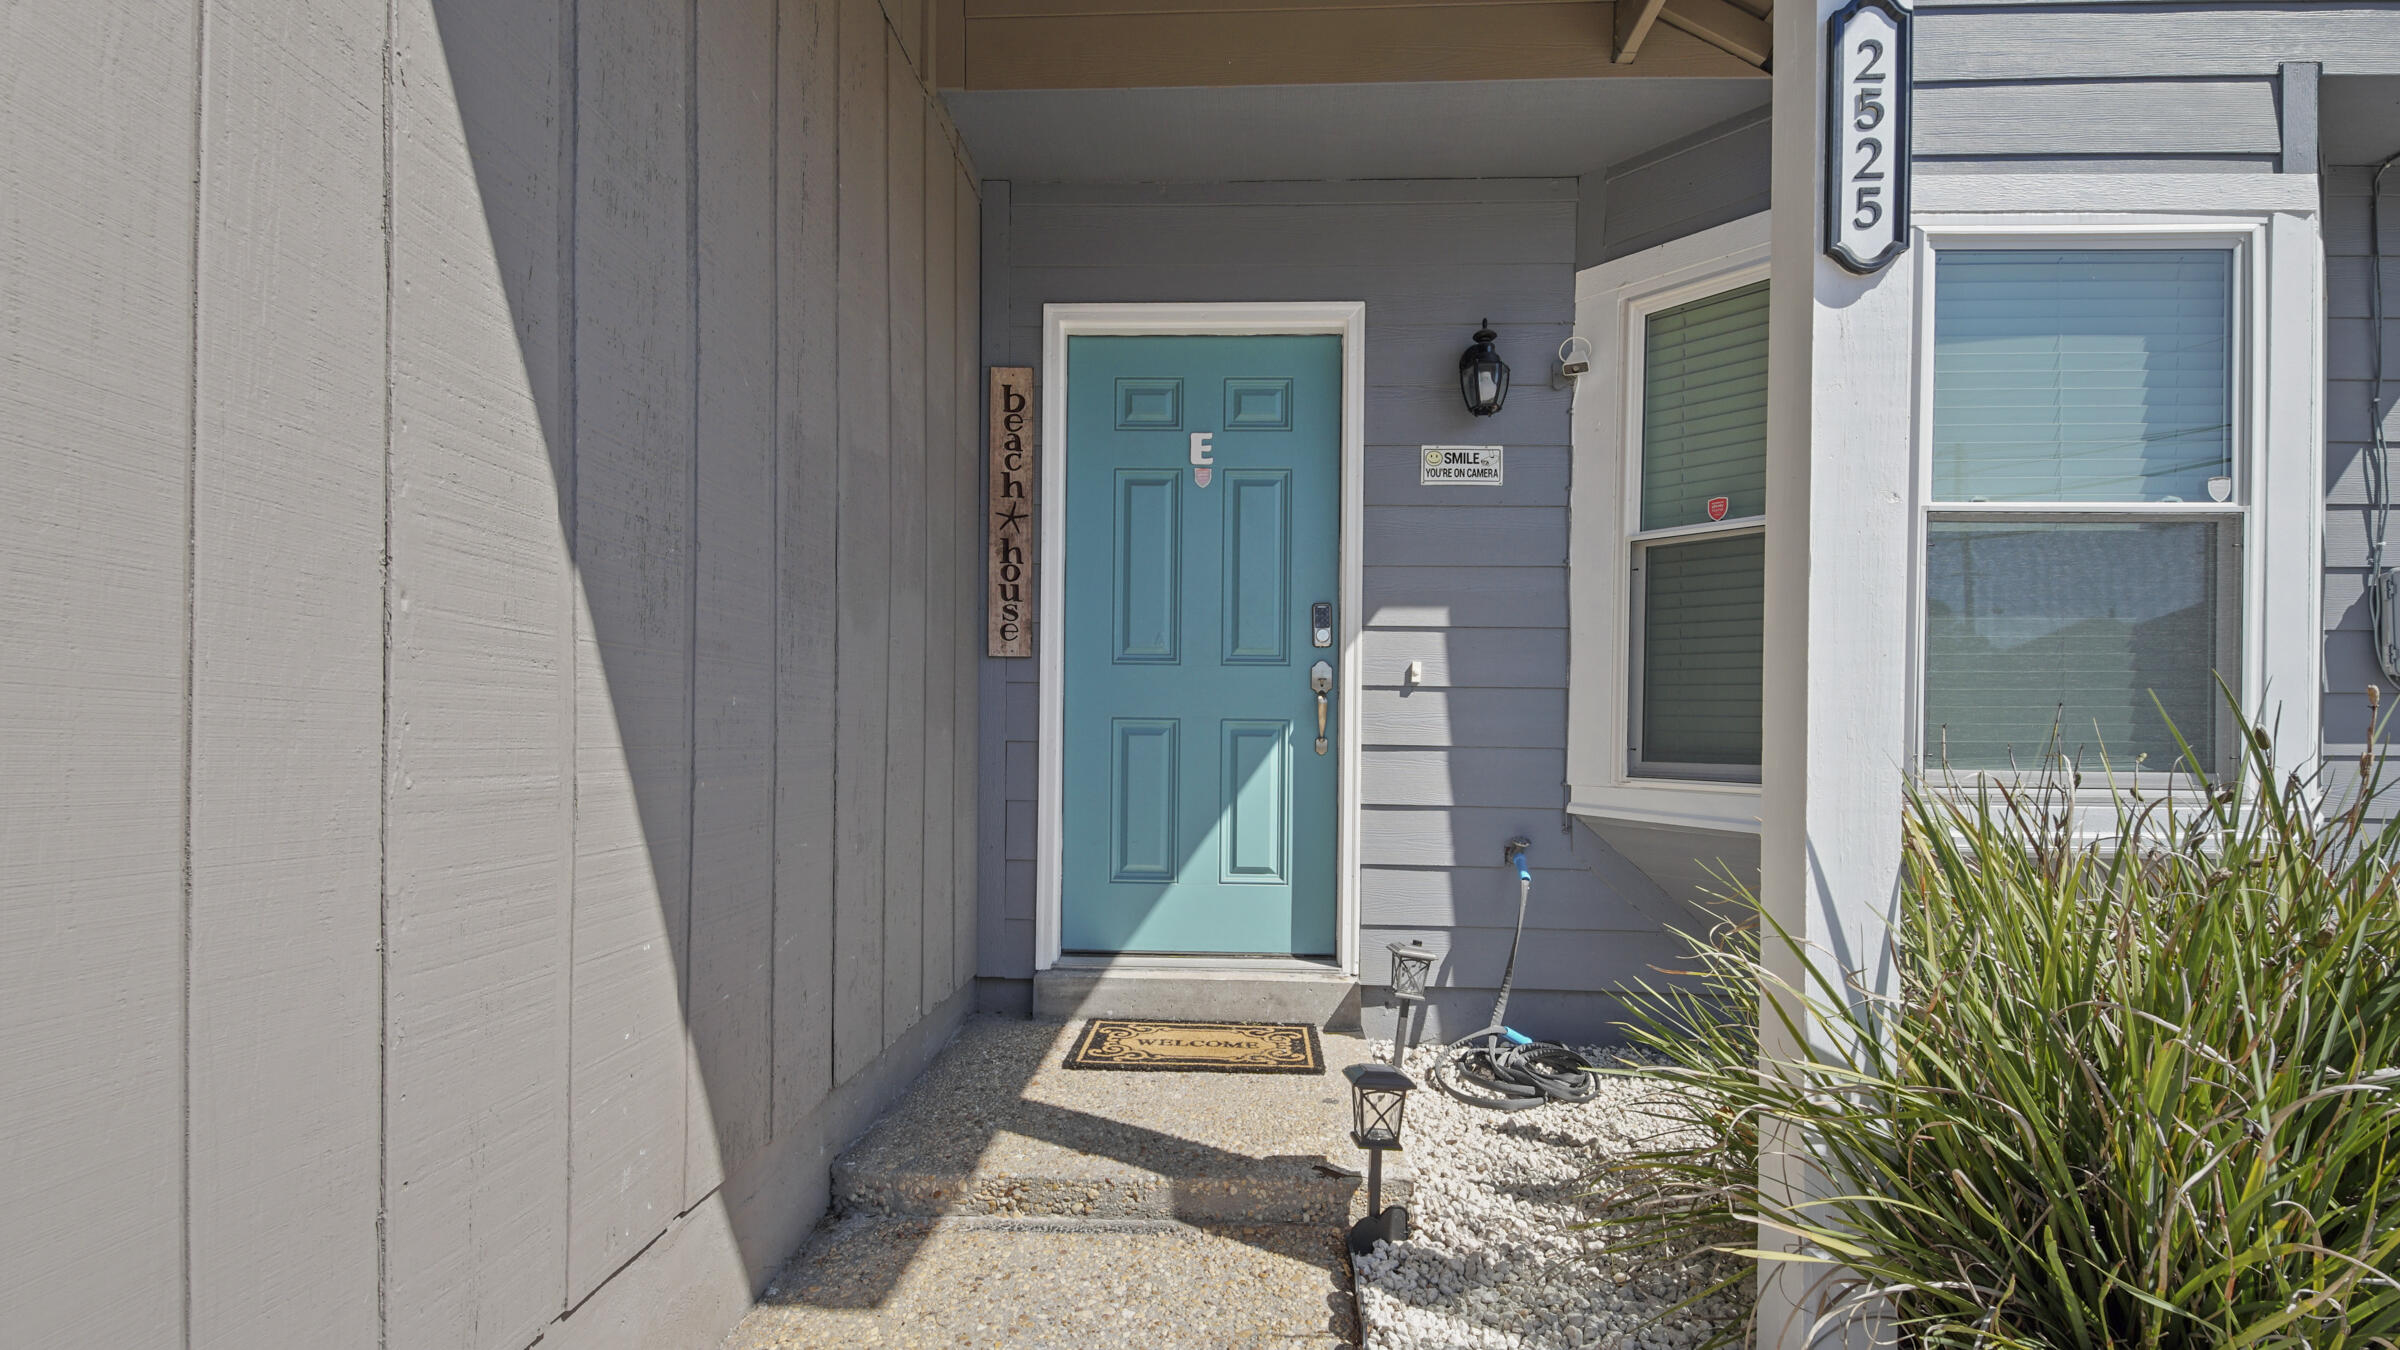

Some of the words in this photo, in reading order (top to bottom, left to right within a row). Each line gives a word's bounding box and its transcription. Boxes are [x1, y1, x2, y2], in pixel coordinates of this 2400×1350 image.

[1853, 38, 1887, 230] 2525
[999, 384, 1026, 500] beach
[1190, 432, 1214, 465] E
[1444, 452, 1480, 465] SMILE
[1425, 468, 1453, 478] YOU'RE
[1454, 468, 1465, 478] ON
[1466, 468, 1499, 478] CAMERA
[998, 537, 1025, 642] house
[1137, 1037, 1259, 1050] WELCOME
